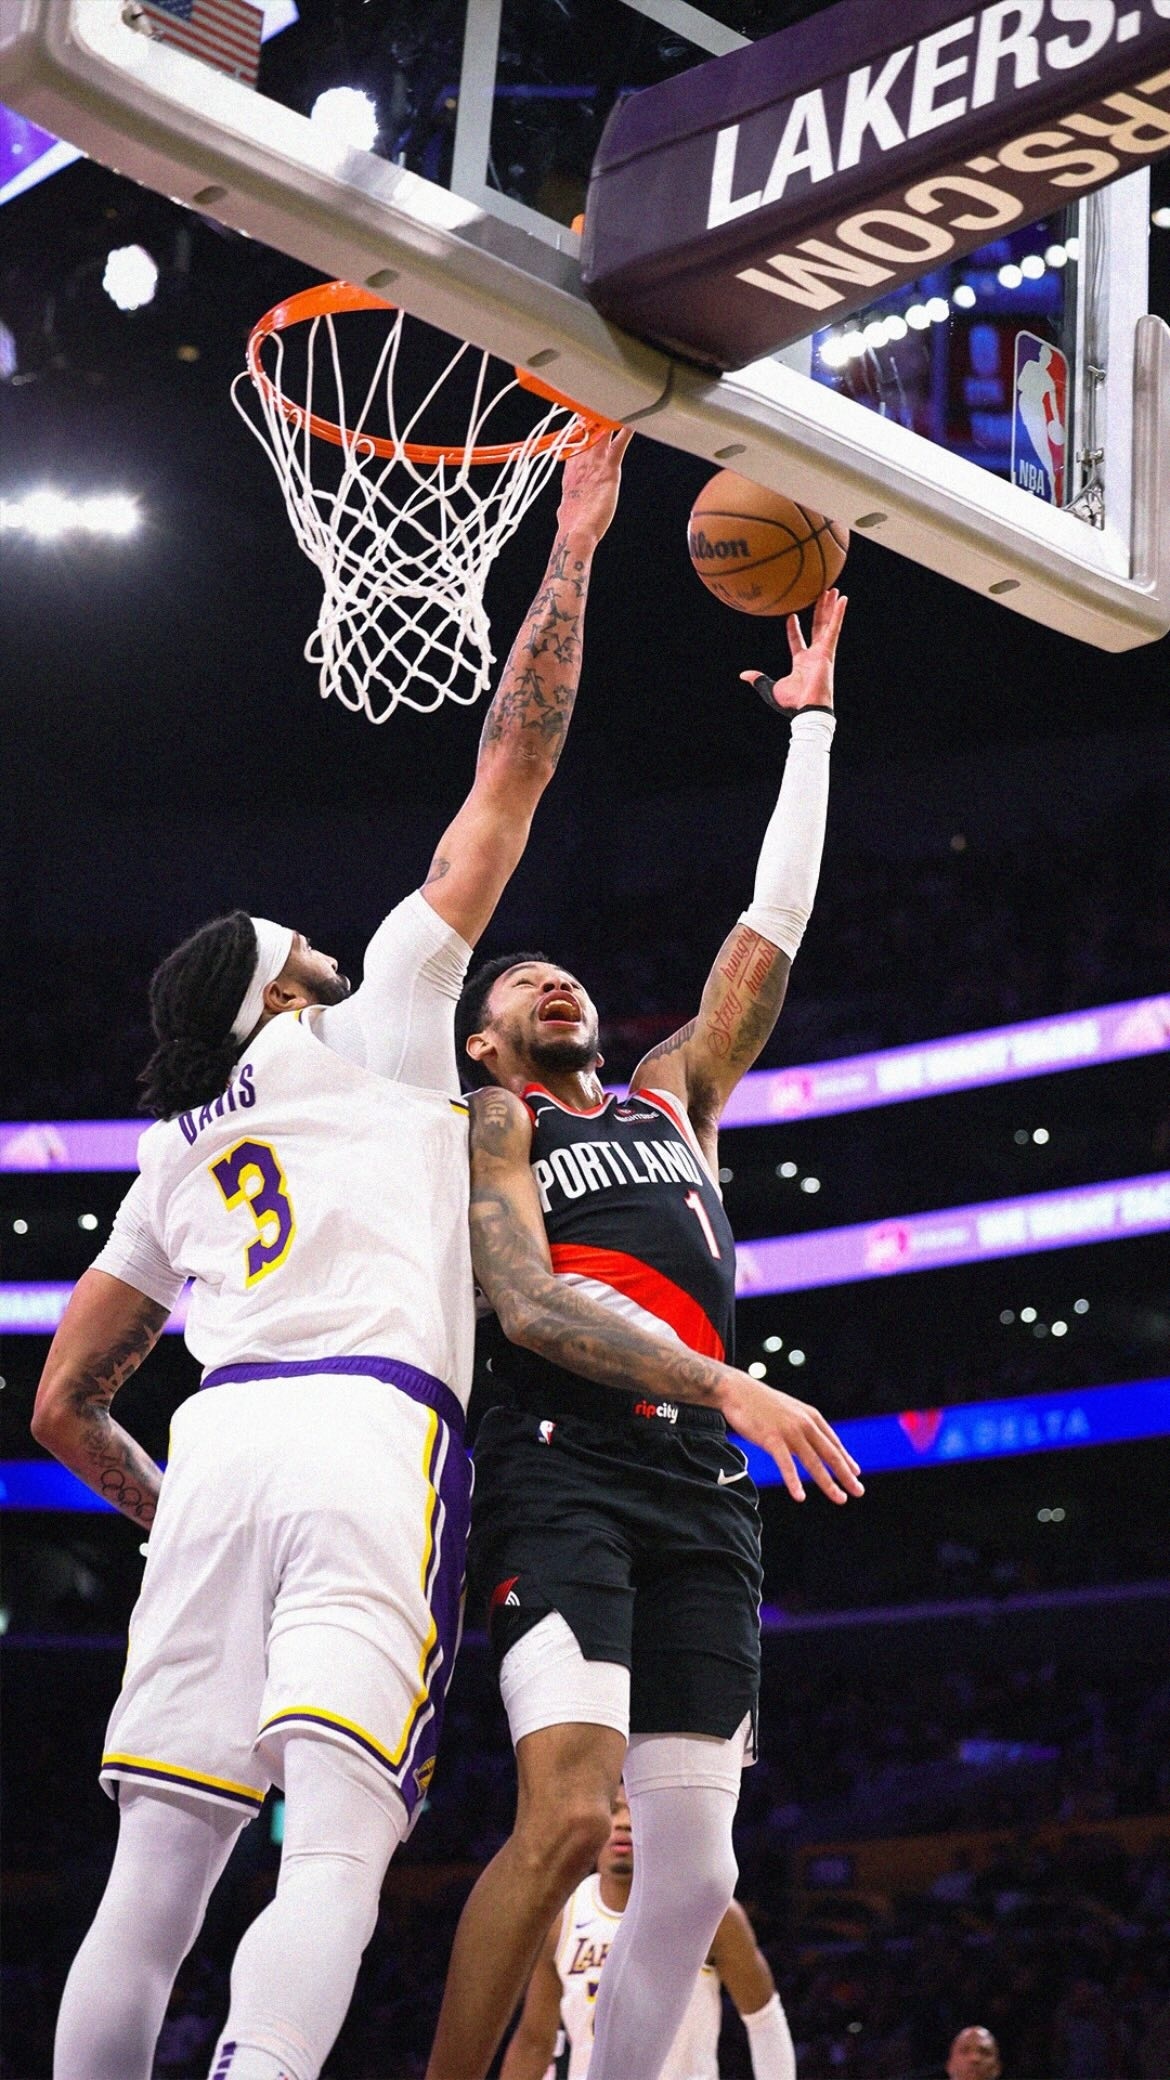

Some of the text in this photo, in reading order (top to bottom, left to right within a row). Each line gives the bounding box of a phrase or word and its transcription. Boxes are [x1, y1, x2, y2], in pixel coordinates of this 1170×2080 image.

[706, 0, 1170, 230] LAKERS.
[736, 68, 1170, 311] RS.COM
[1018, 458, 1045, 496] NBA
[690, 531, 751, 559] ilson
[720, 929, 758, 983] hungry
[707, 988, 743, 1060] Stay
[178, 1063, 256, 1146] DAVIS
[208, 1136, 297, 1289] 3
[532, 1141, 703, 1213] PORTLAND
[683, 1188, 721, 1260] 1
